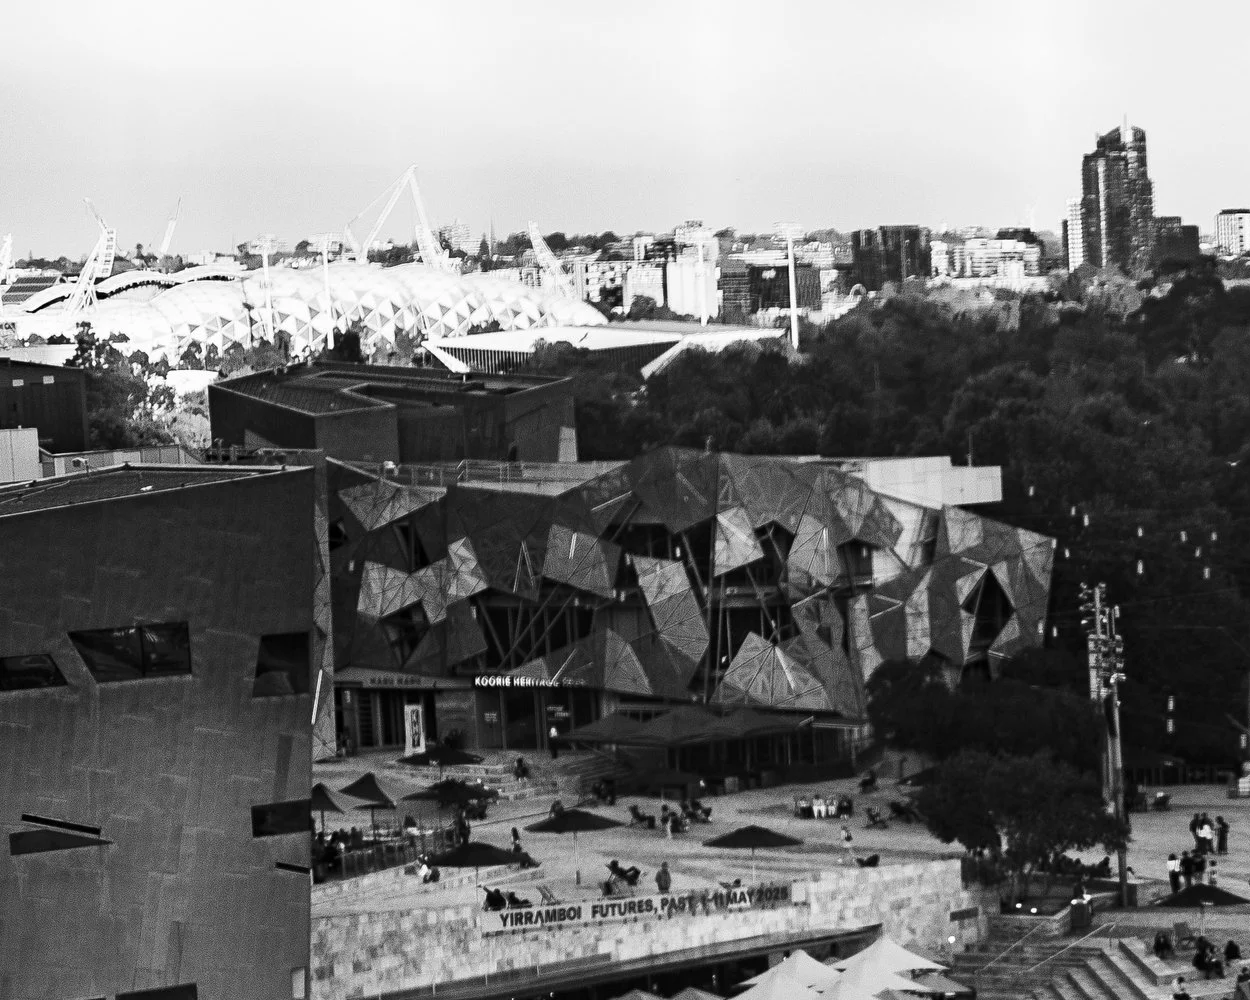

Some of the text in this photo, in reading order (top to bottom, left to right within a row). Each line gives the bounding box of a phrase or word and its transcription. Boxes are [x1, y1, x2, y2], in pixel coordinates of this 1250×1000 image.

[474, 675, 511, 687] KOORIE
[500, 905, 582, 927] YIRRAMBOI
[591, 898, 658, 919] FUTURES,
